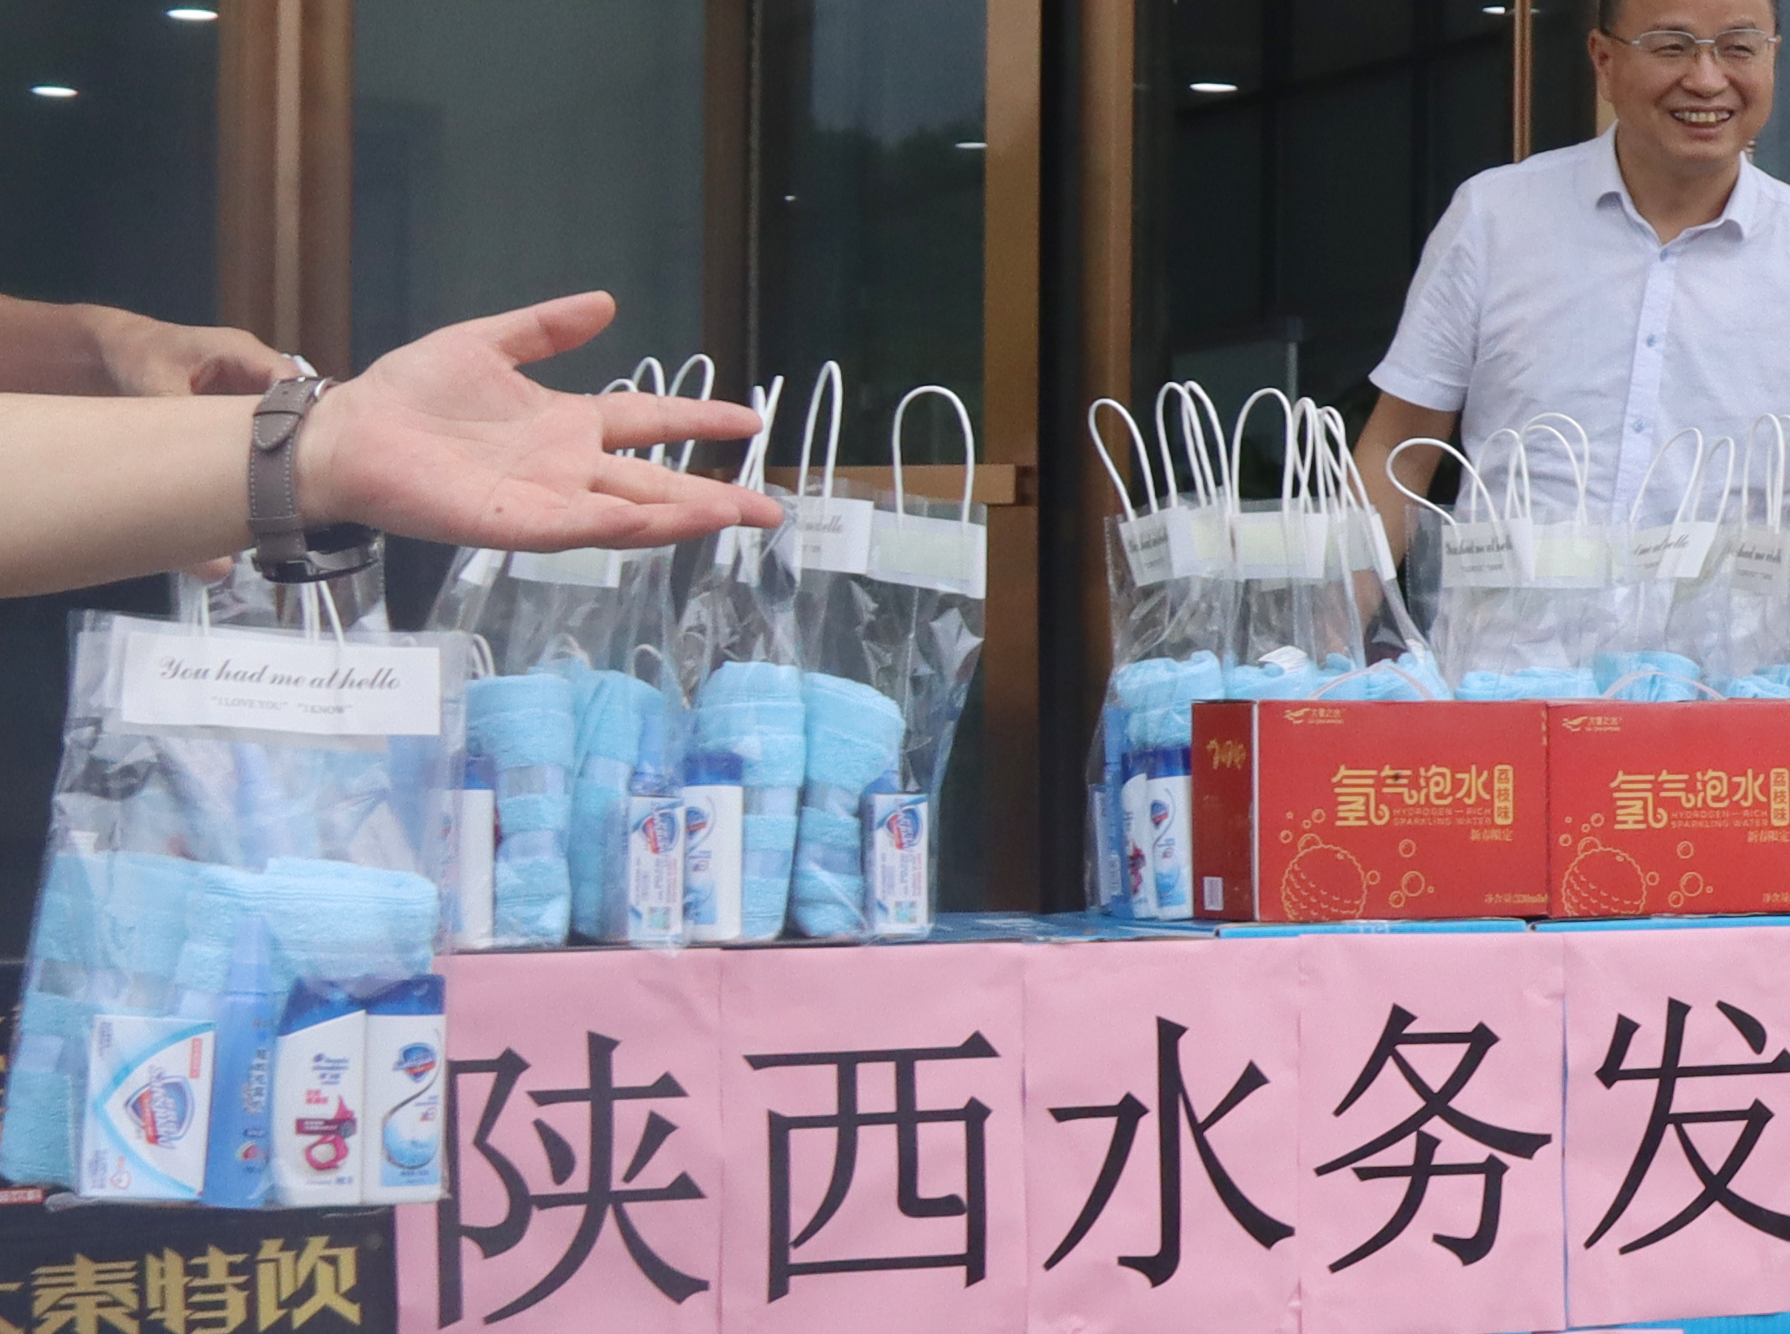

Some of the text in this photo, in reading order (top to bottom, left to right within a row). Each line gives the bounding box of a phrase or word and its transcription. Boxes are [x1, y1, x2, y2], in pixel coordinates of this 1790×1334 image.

[158, 656, 401, 691] You had me at hello
[1331, 764, 1491, 827] 氢气泡水
[1610, 769, 1768, 830] 氢气泡水
